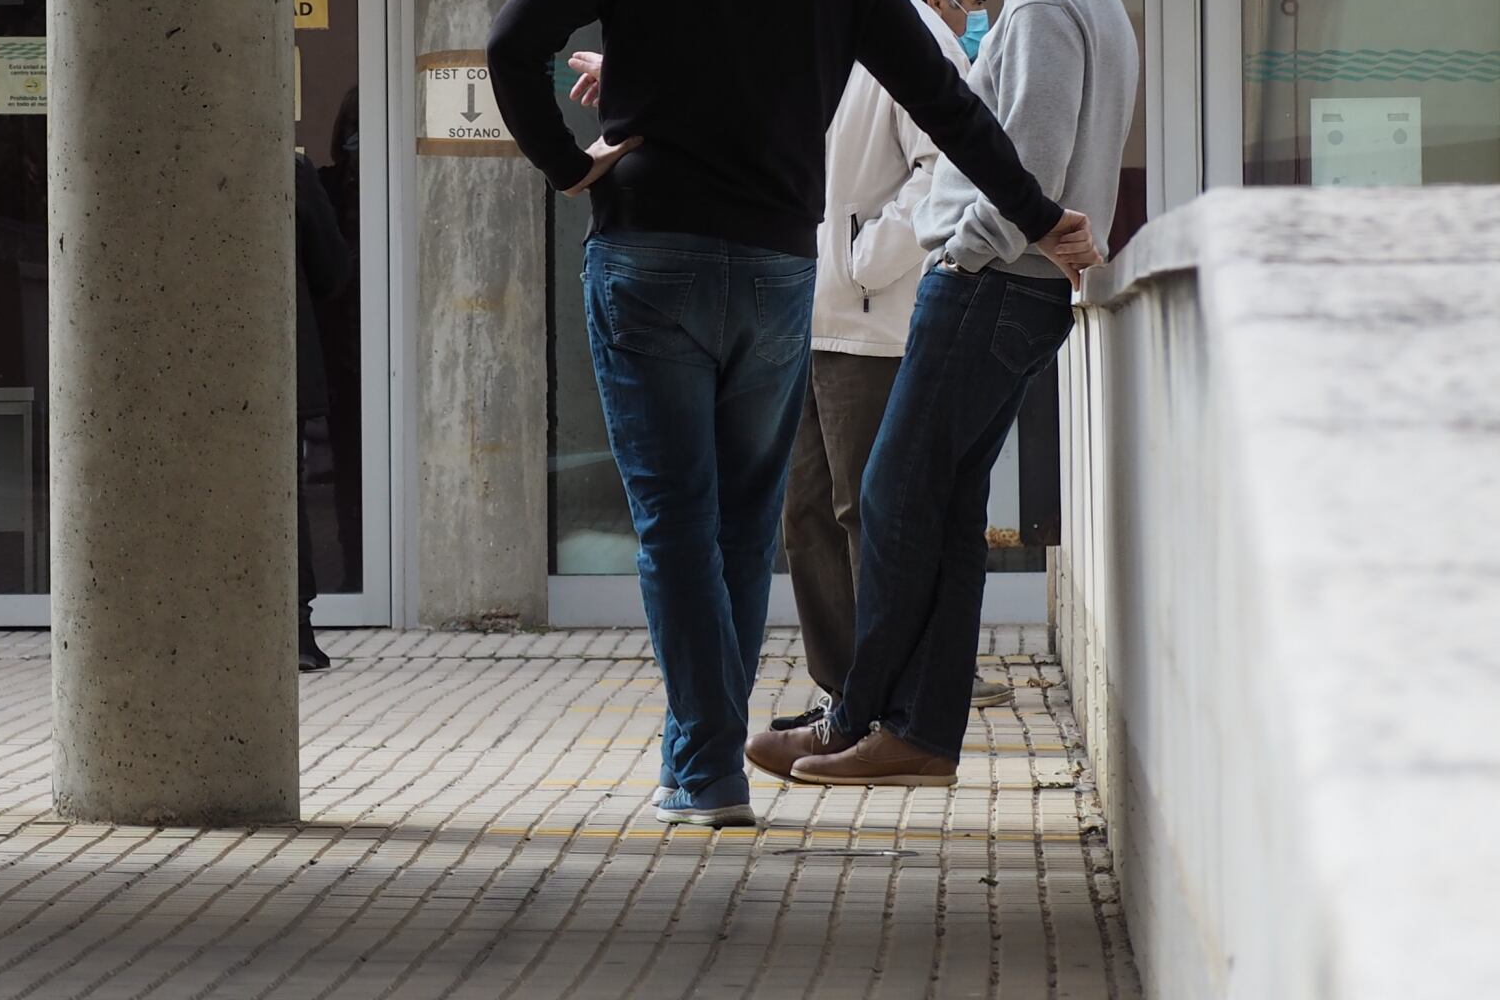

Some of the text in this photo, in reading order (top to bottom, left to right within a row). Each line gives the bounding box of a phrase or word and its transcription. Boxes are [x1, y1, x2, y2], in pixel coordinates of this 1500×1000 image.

[293, 2, 313, 16] D
[428, 68, 459, 80] TEST
[448, 125, 501, 138] SÓTANO
